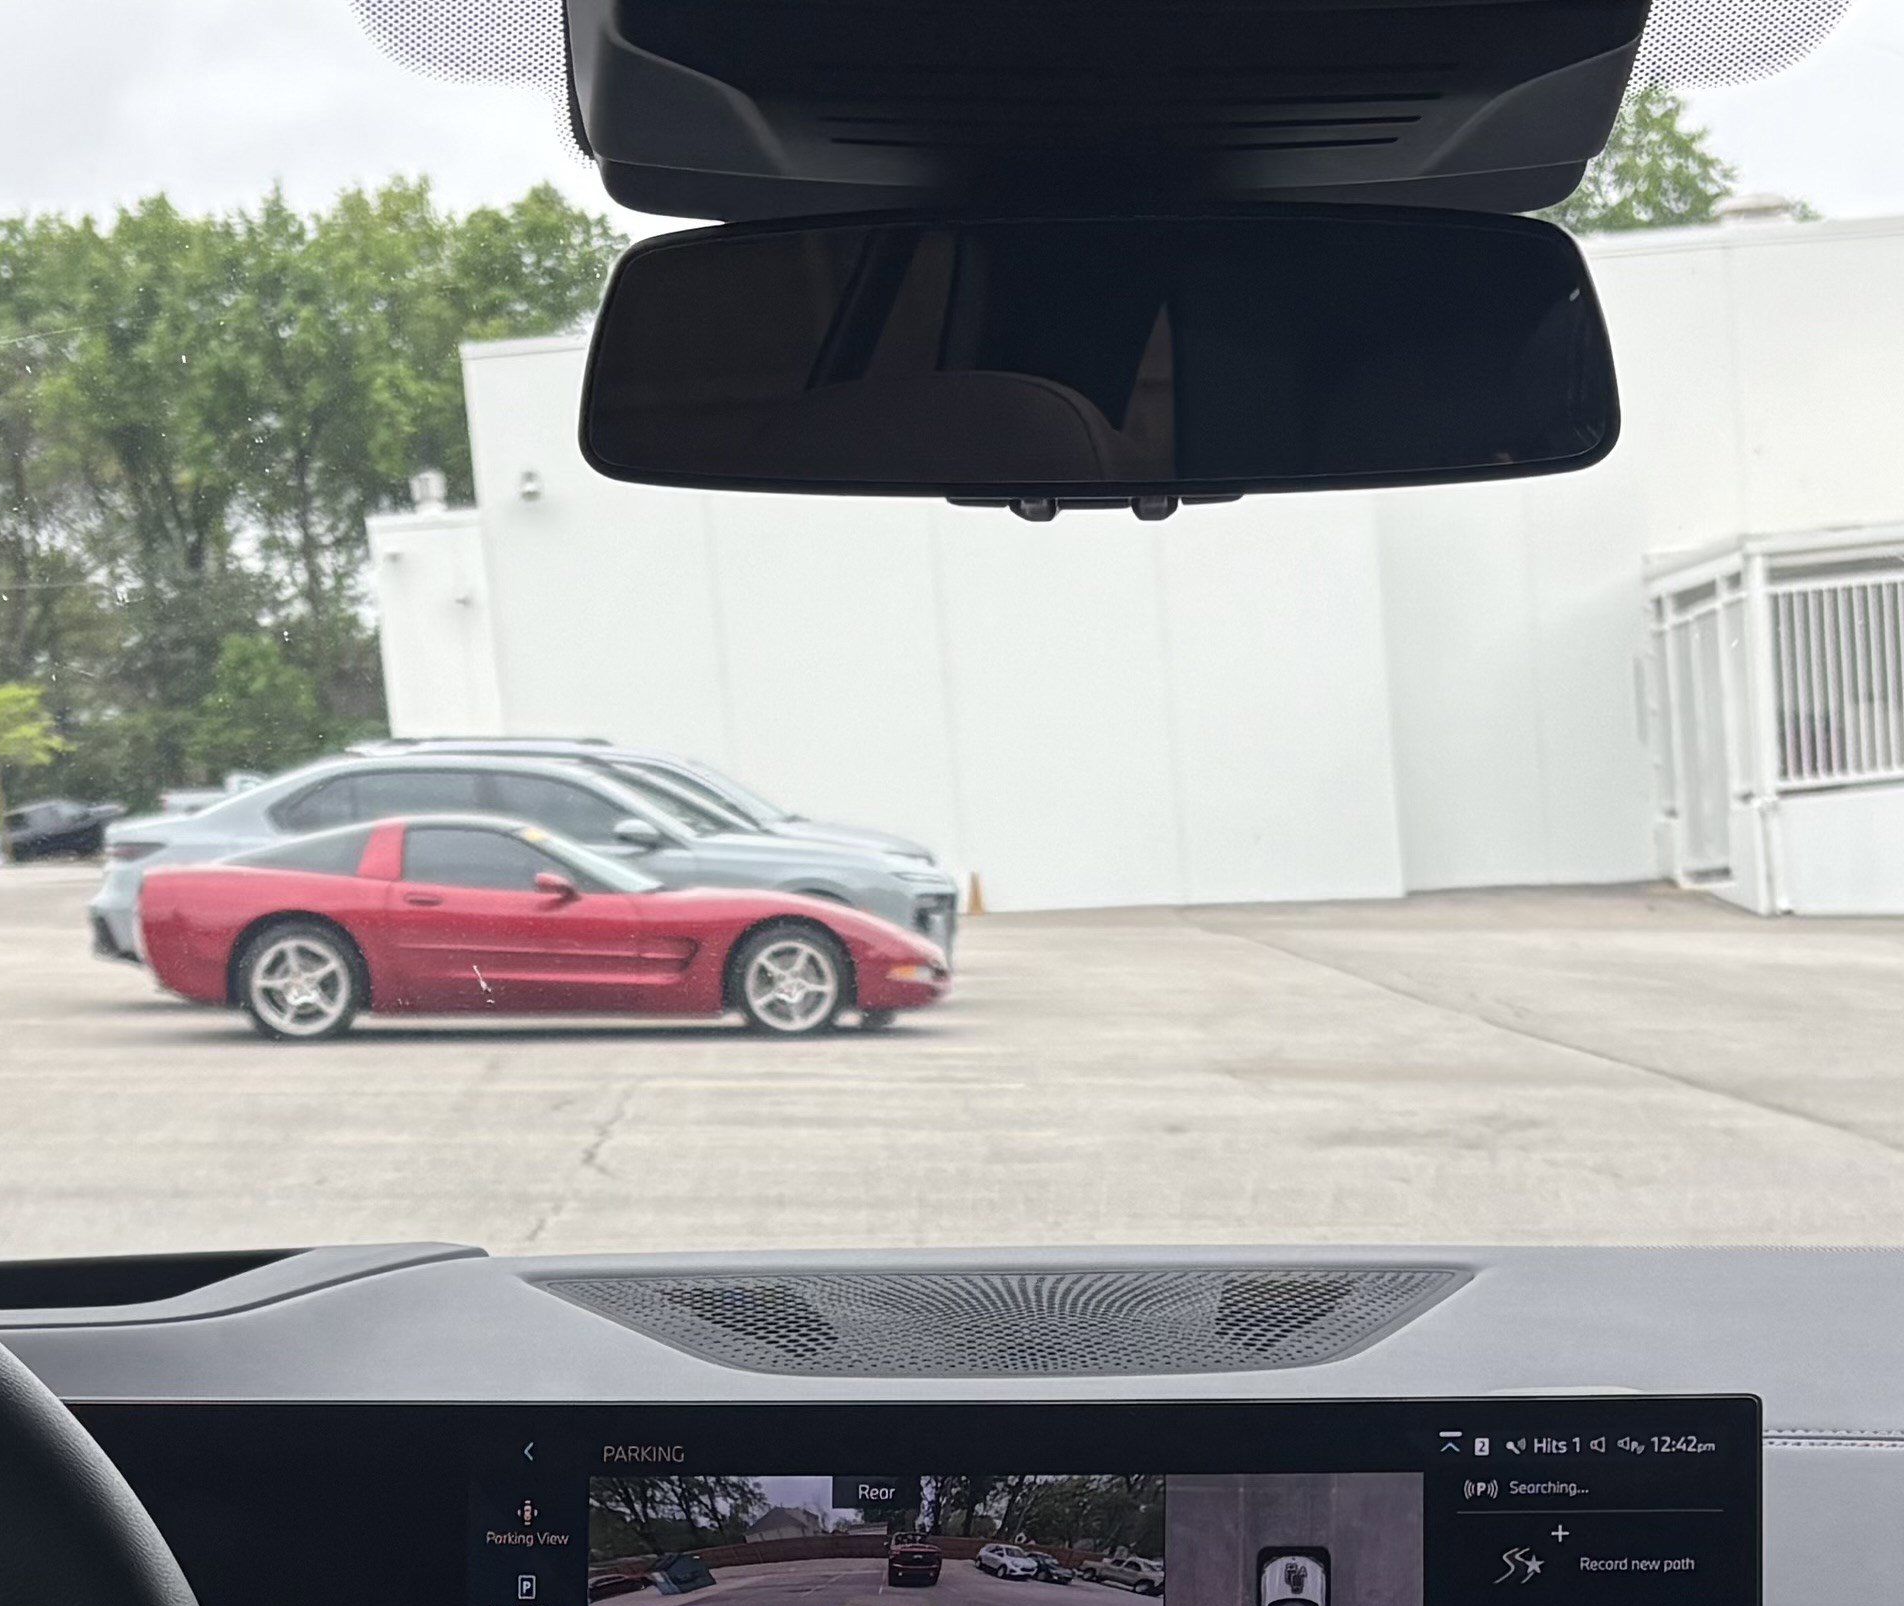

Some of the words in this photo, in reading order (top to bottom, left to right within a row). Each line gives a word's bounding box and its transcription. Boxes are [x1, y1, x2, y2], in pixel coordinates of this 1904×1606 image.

[602, 1445, 685, 1463] PARKING
[1533, 1437, 1567, 1454] Hits
[1573, 1437, 1582, 1453] 1
[858, 1483, 896, 1500] Rear
[1508, 1480, 1589, 1497] Searching...
[486, 1531, 534, 1547] Parking
[537, 1531, 569, 1545] View
[1579, 1556, 1628, 1572] Record
[1631, 1560, 1660, 1572] new
[1663, 1556, 1696, 1573] path
